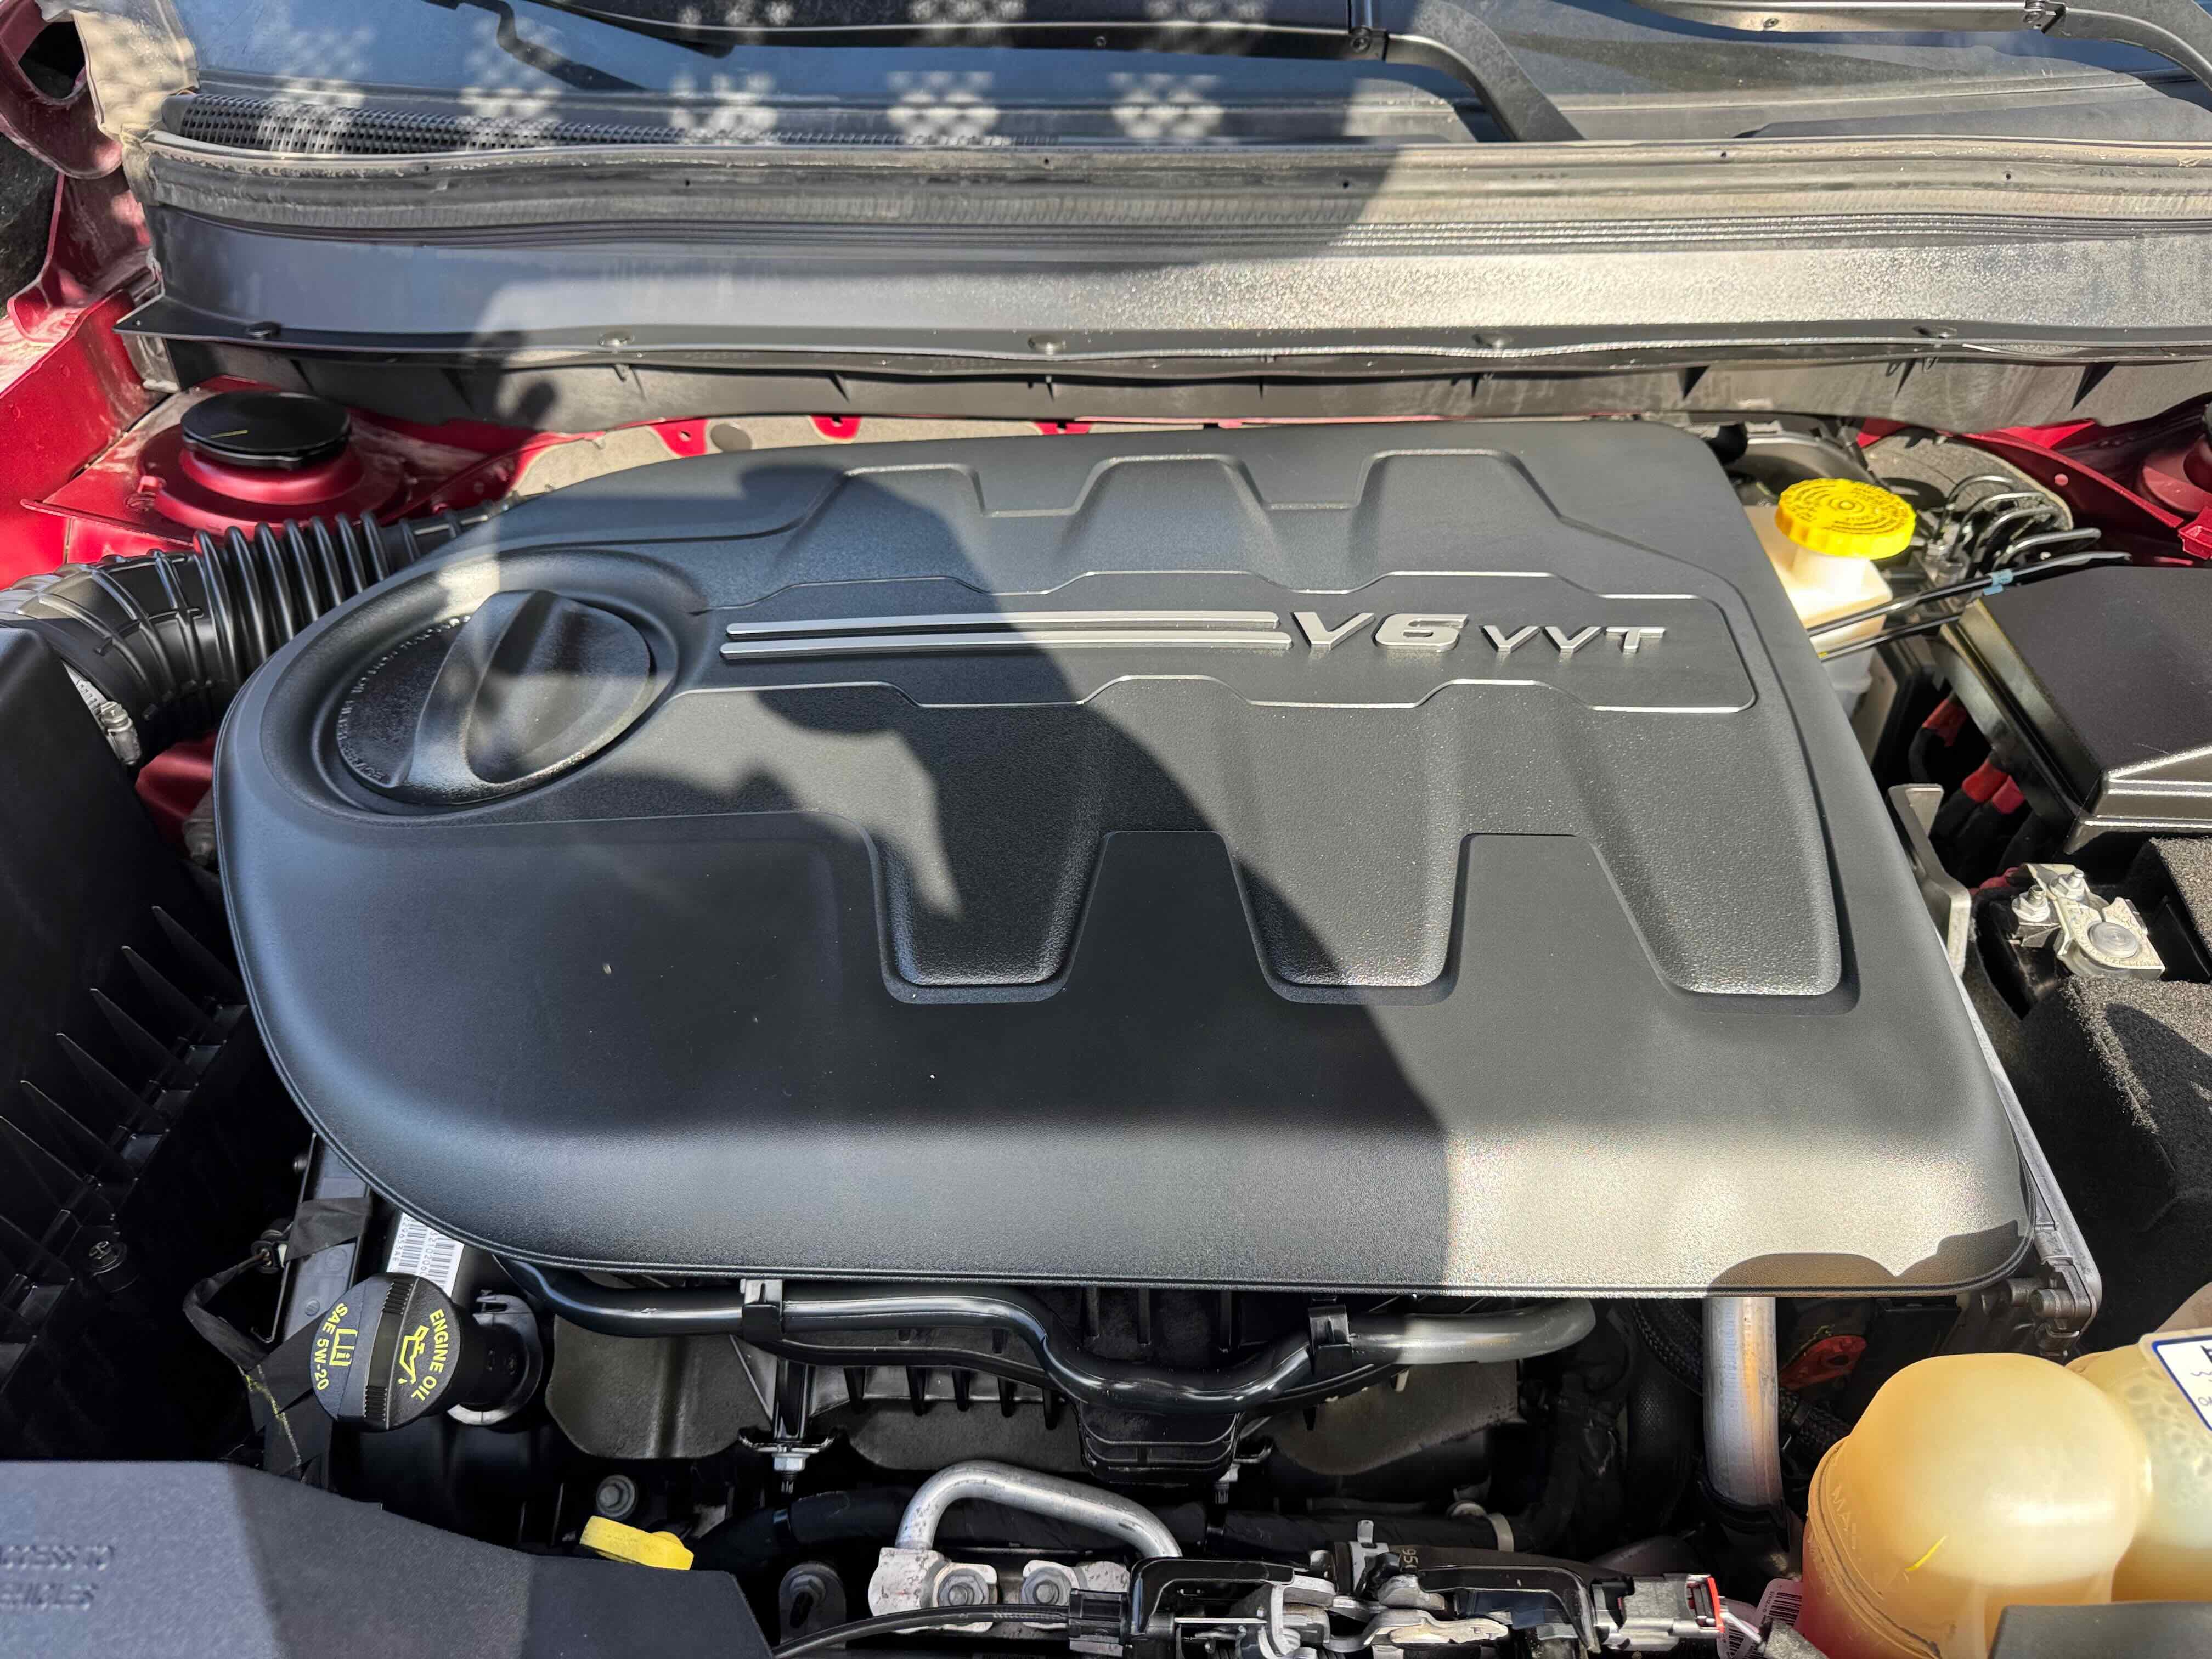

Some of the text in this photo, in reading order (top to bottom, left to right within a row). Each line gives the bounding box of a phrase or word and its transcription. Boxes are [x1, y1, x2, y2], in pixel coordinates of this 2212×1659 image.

[1290, 611, 1666, 654] V6 VVT
[313, 1303, 348, 1391] SAE 5W-20
[411, 1308, 449, 1401] ENGINE OIL
